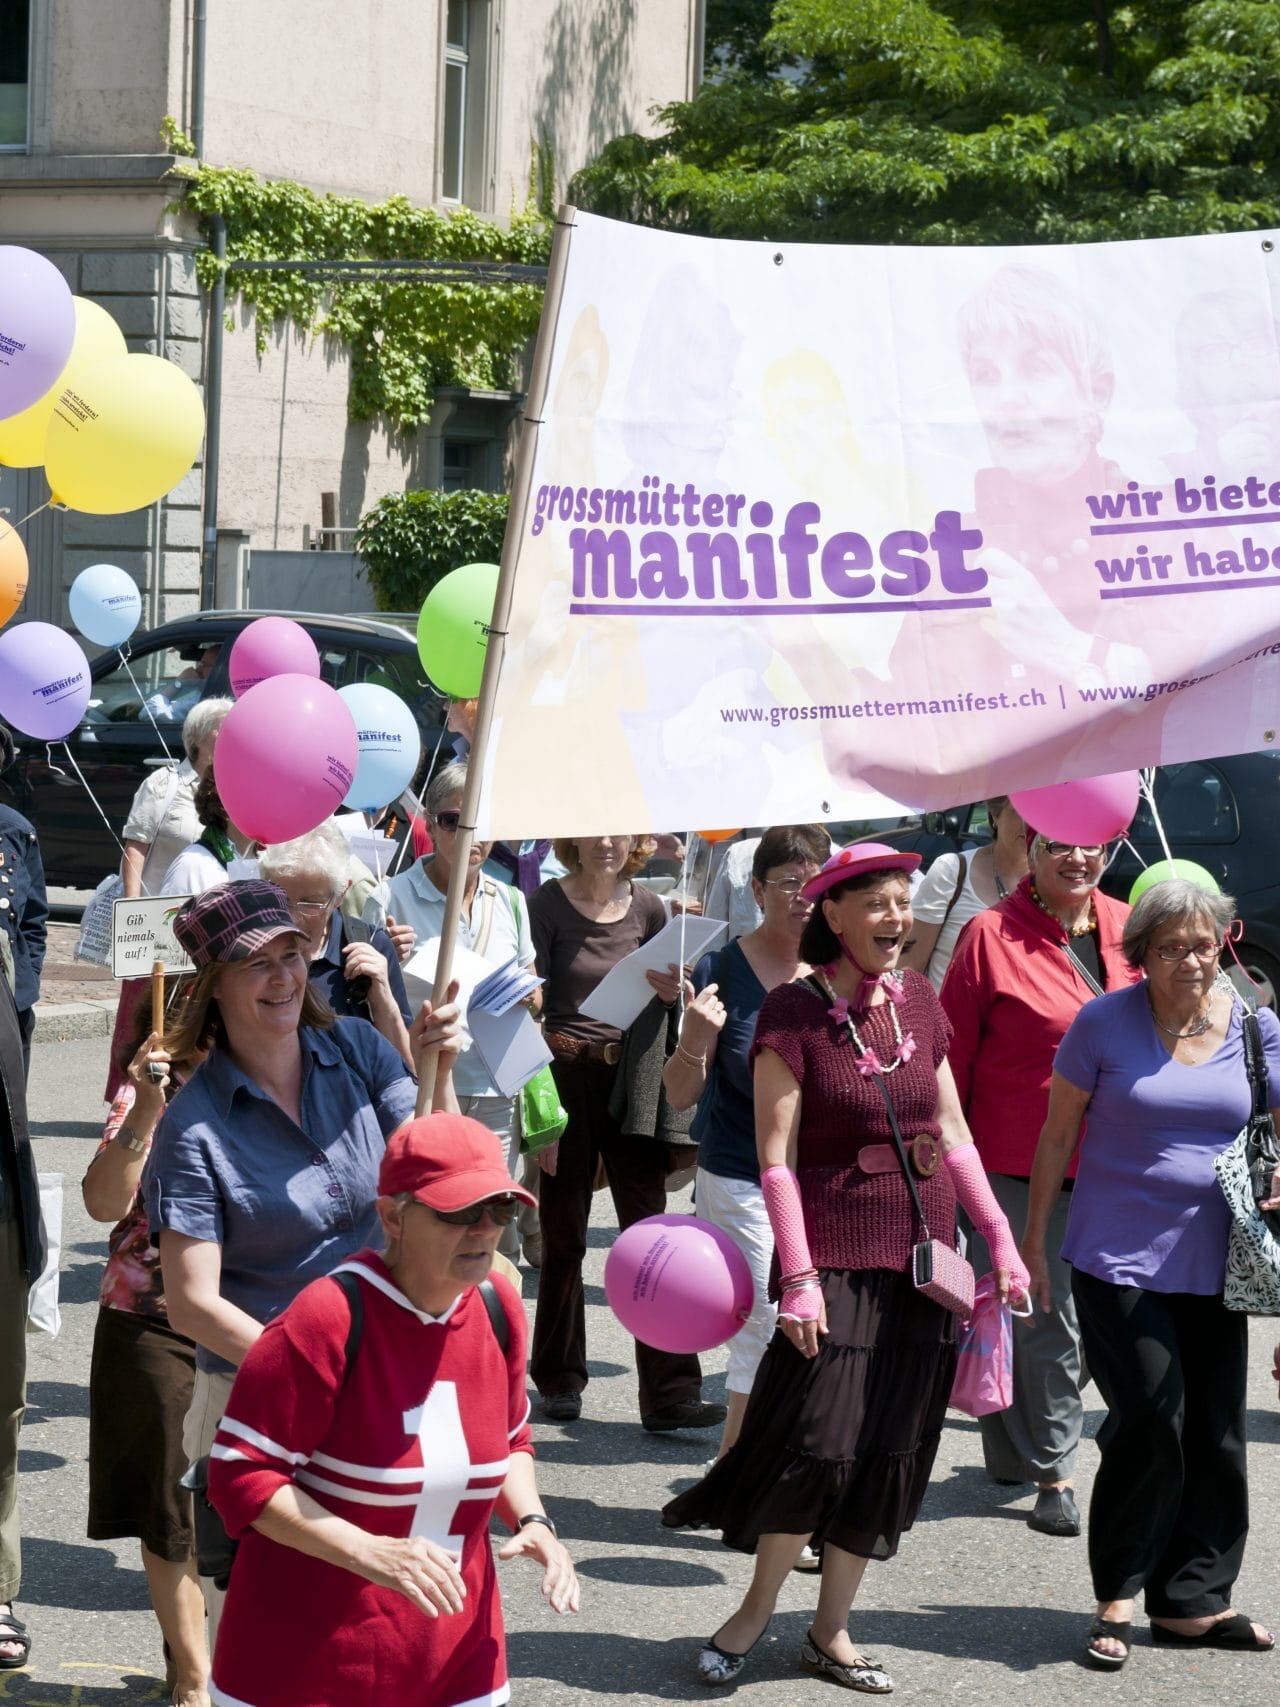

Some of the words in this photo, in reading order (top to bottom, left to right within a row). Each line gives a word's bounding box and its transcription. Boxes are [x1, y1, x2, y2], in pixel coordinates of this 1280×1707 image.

[532, 475, 745, 536] grossmütter
[1085, 481, 1163, 519] wir
[569, 501, 988, 600] manifest
[1094, 545, 1173, 583] wir
[41, 672, 83, 697] manifest
[720, 688, 1047, 728] www.grossmuettermanifest.ch
[117, 930, 155, 943] niemals
